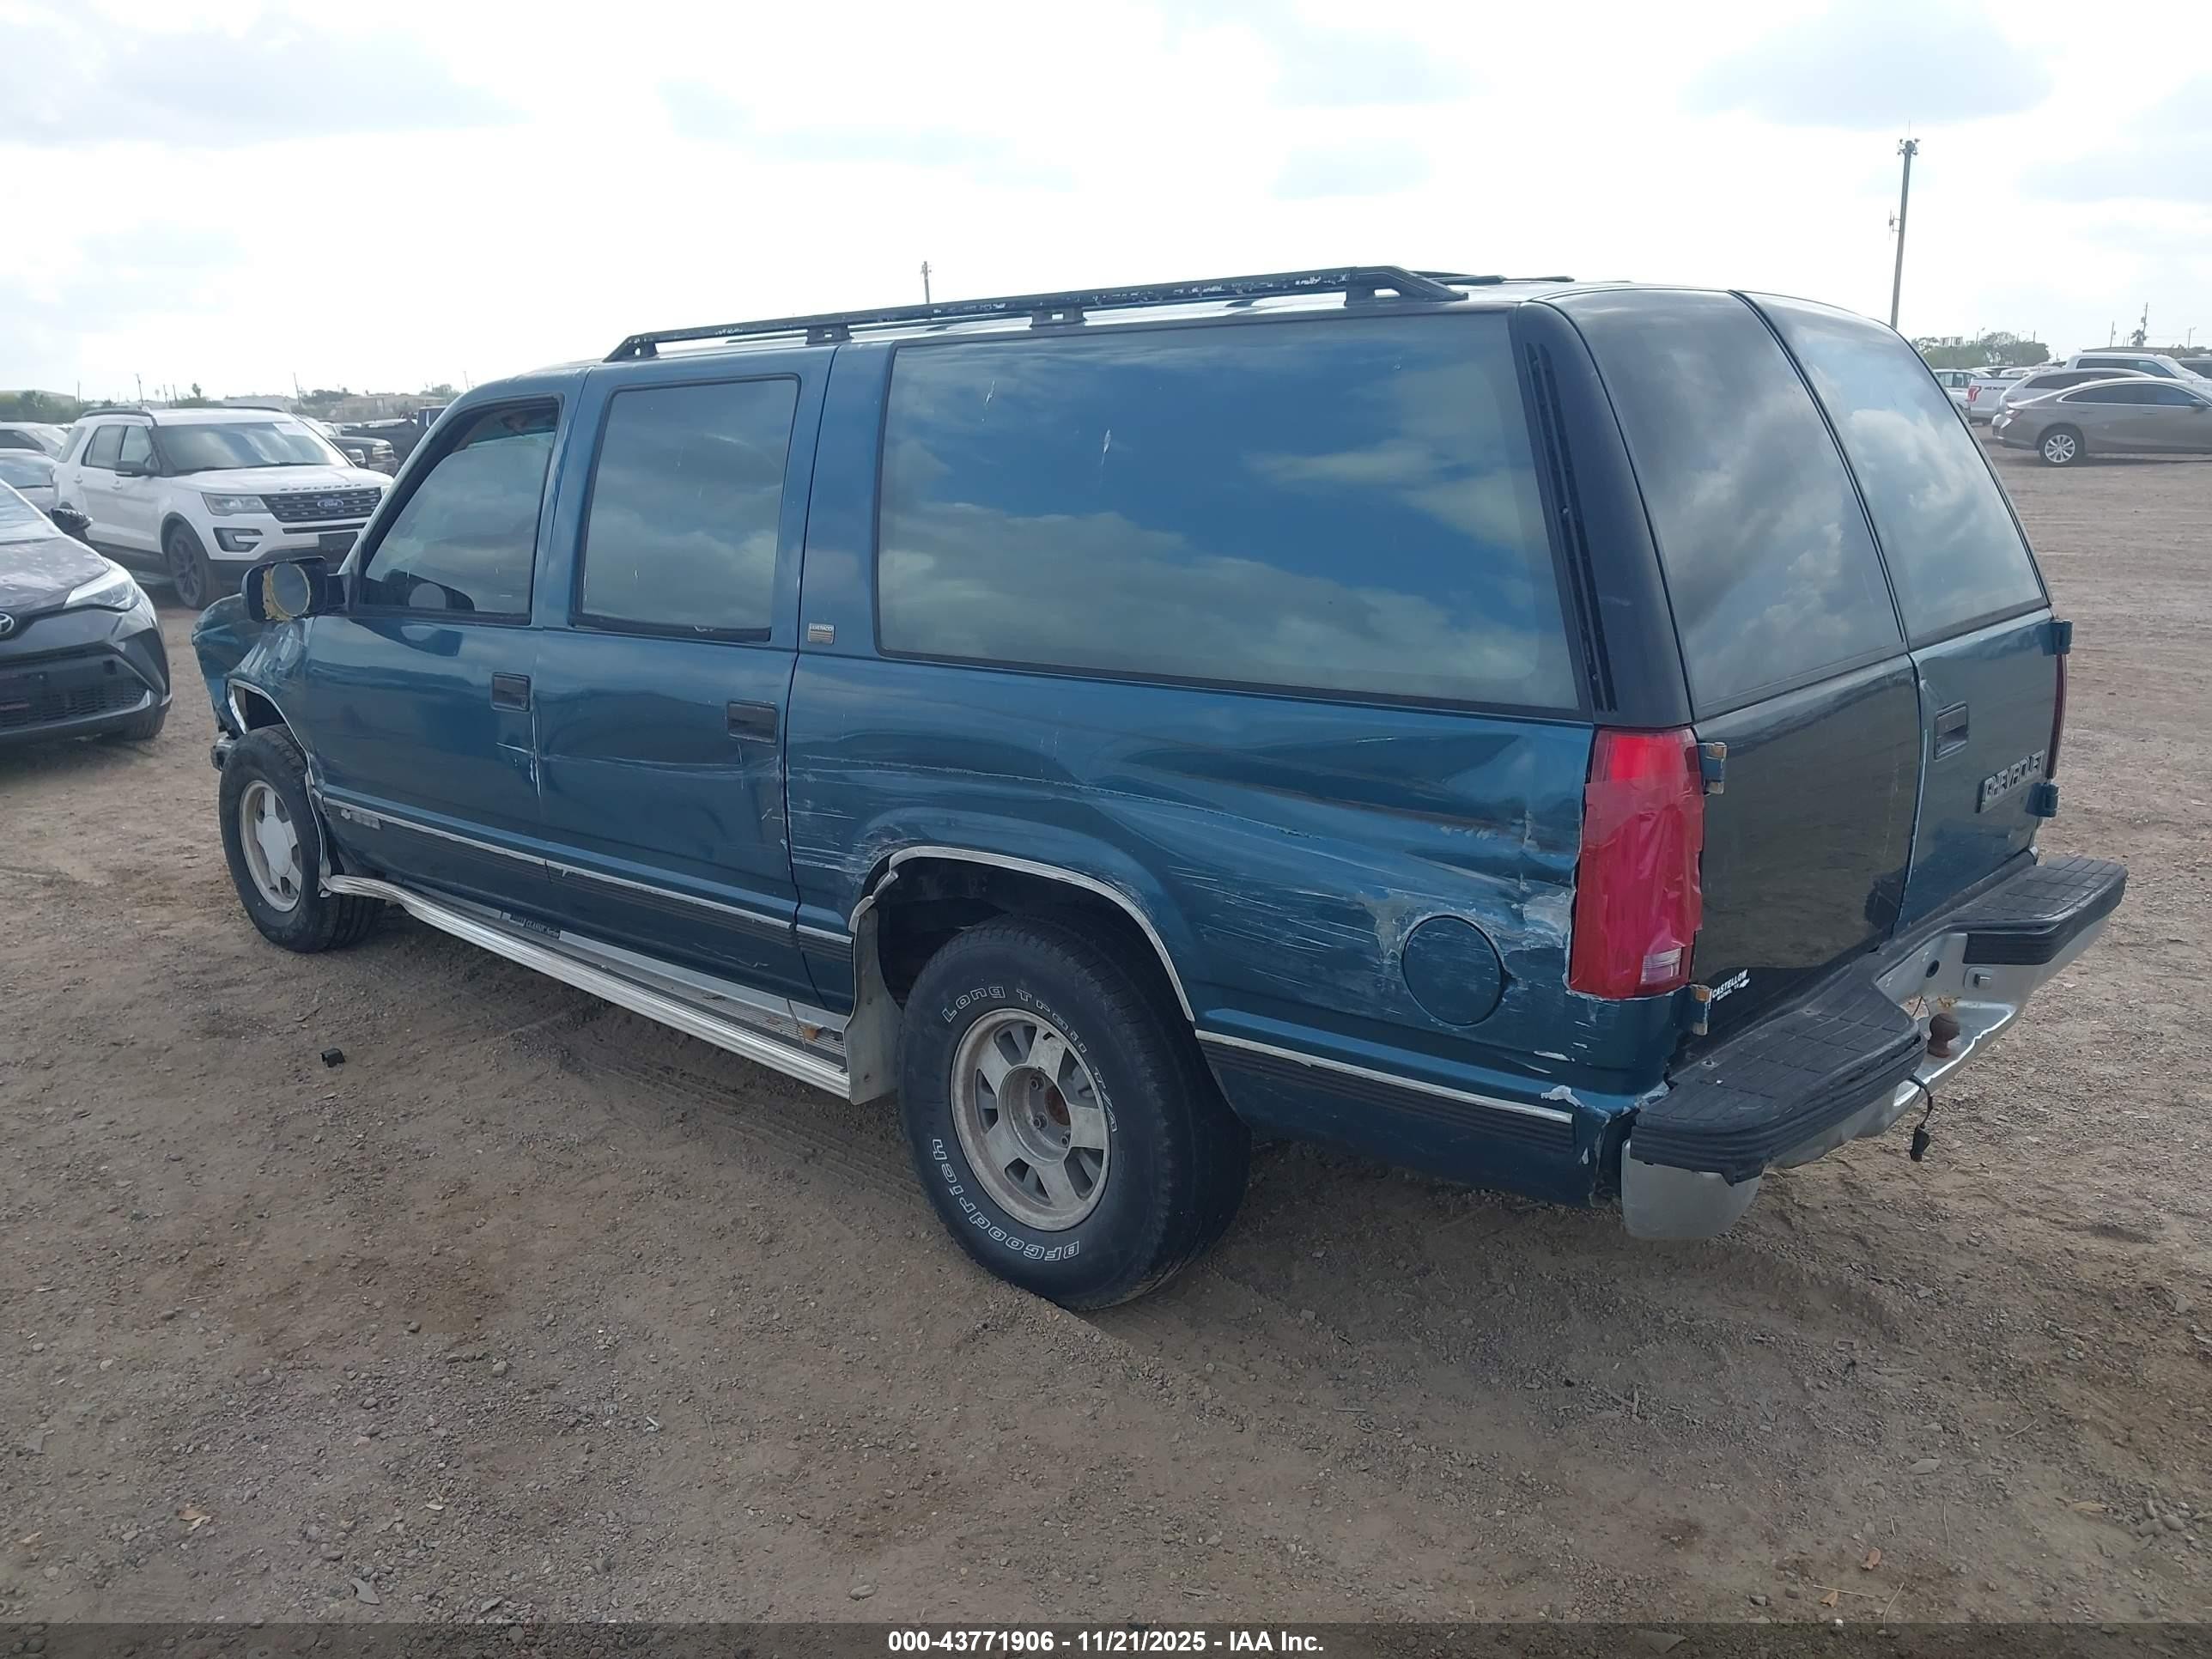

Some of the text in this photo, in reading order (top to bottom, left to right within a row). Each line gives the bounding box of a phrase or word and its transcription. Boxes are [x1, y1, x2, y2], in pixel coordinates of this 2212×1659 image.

[1712, 968, 1748, 999] CASTELLOW
[942, 984, 1006, 1024] Long
[1016, 988, 1089, 1054] Trail
[932, 1138, 1080, 1261] BFGoodrich
